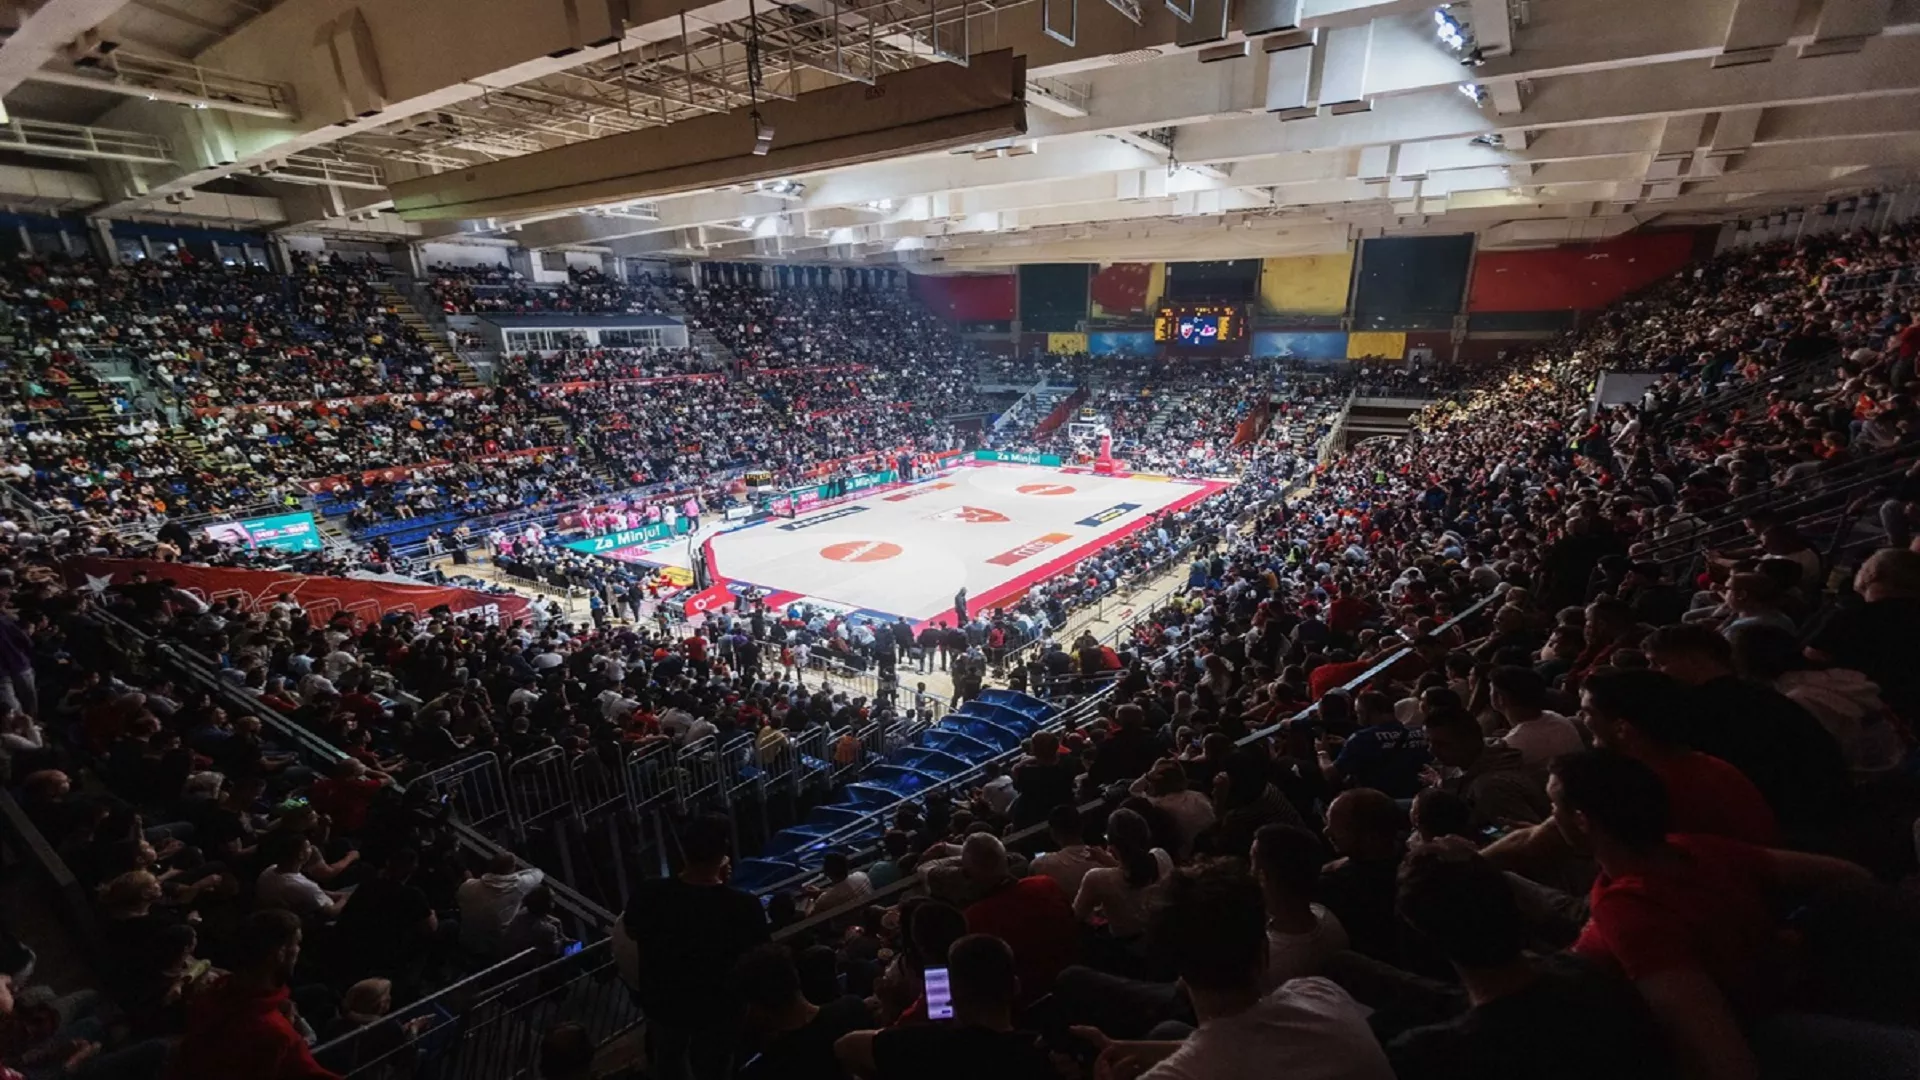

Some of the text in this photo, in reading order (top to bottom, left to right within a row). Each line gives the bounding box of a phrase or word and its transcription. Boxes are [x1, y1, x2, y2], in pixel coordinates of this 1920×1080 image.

[997, 452, 1041, 465] Za Minju!
[855, 474, 881, 488] Minju!
[595, 525, 661, 550] Za Minju!
